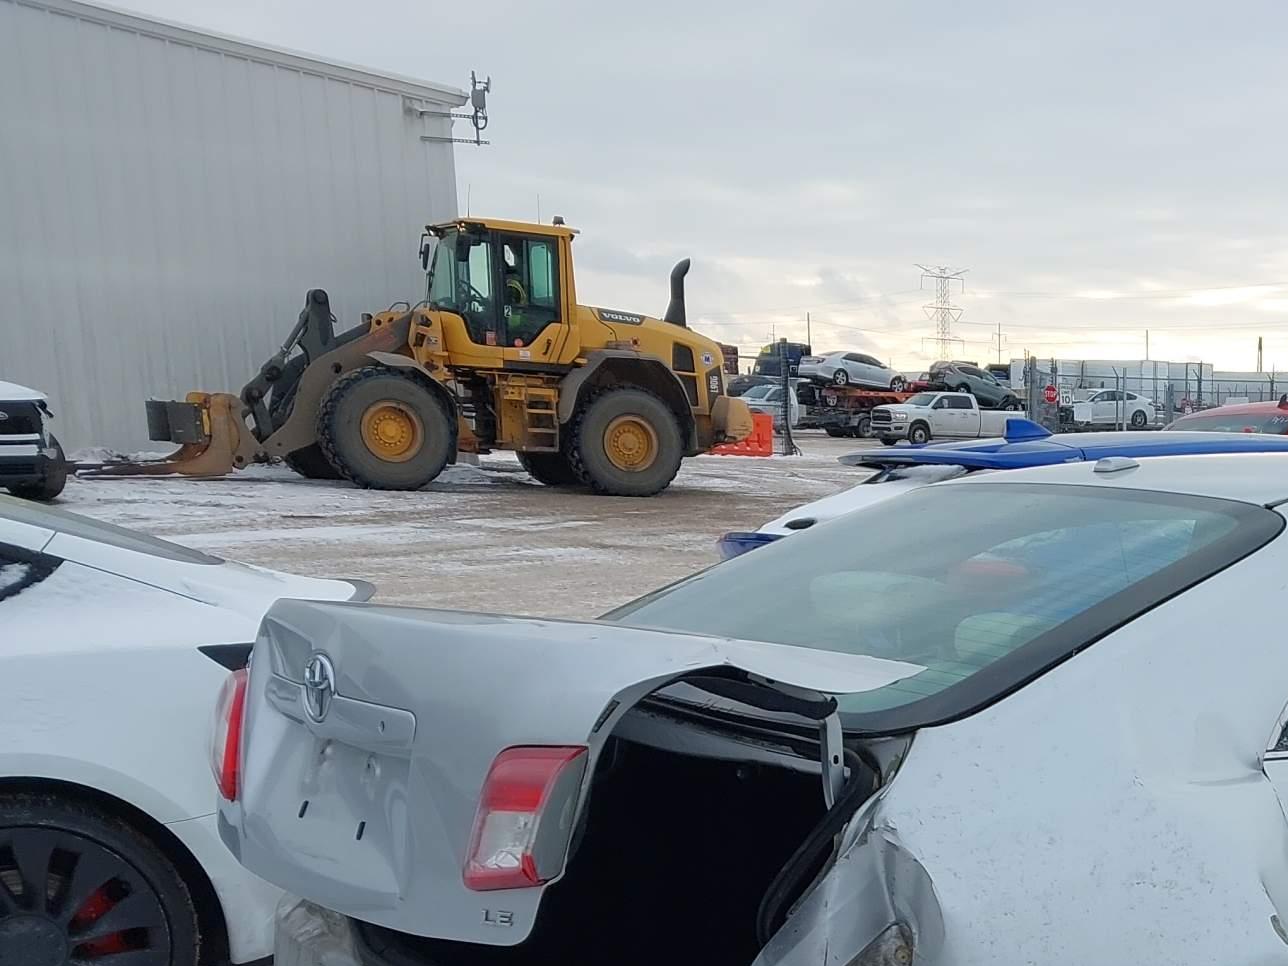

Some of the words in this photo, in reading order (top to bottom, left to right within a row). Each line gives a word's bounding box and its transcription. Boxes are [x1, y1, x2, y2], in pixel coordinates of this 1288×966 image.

[601, 312, 641, 323] VOLVO
[710, 375, 719, 393] L90G
[1044, 390, 1056, 398] STOP
[1061, 395, 1071, 404] 10
[481, 909, 513, 927] LE
